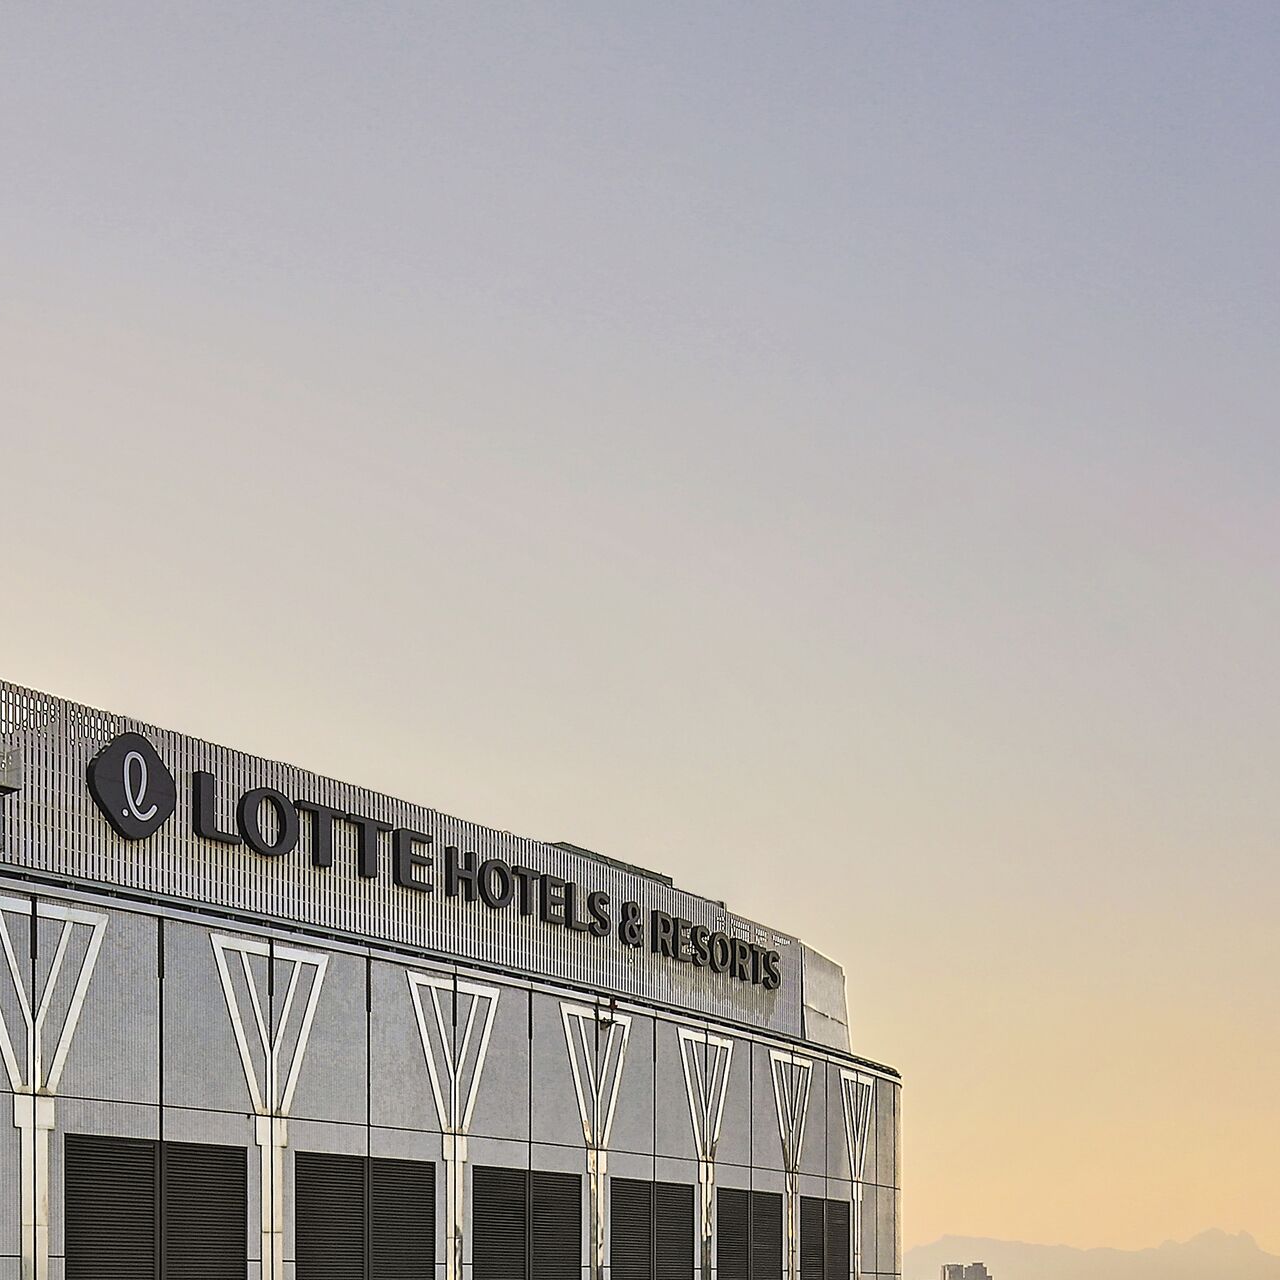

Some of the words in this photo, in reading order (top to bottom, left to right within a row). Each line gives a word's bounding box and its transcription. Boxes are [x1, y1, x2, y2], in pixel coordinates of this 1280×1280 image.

[192, 770, 433, 893] LOTTE
[445, 846, 611, 938] HOTELS
[619, 900, 644, 949] &
[651, 909, 782, 990] RESORTS
